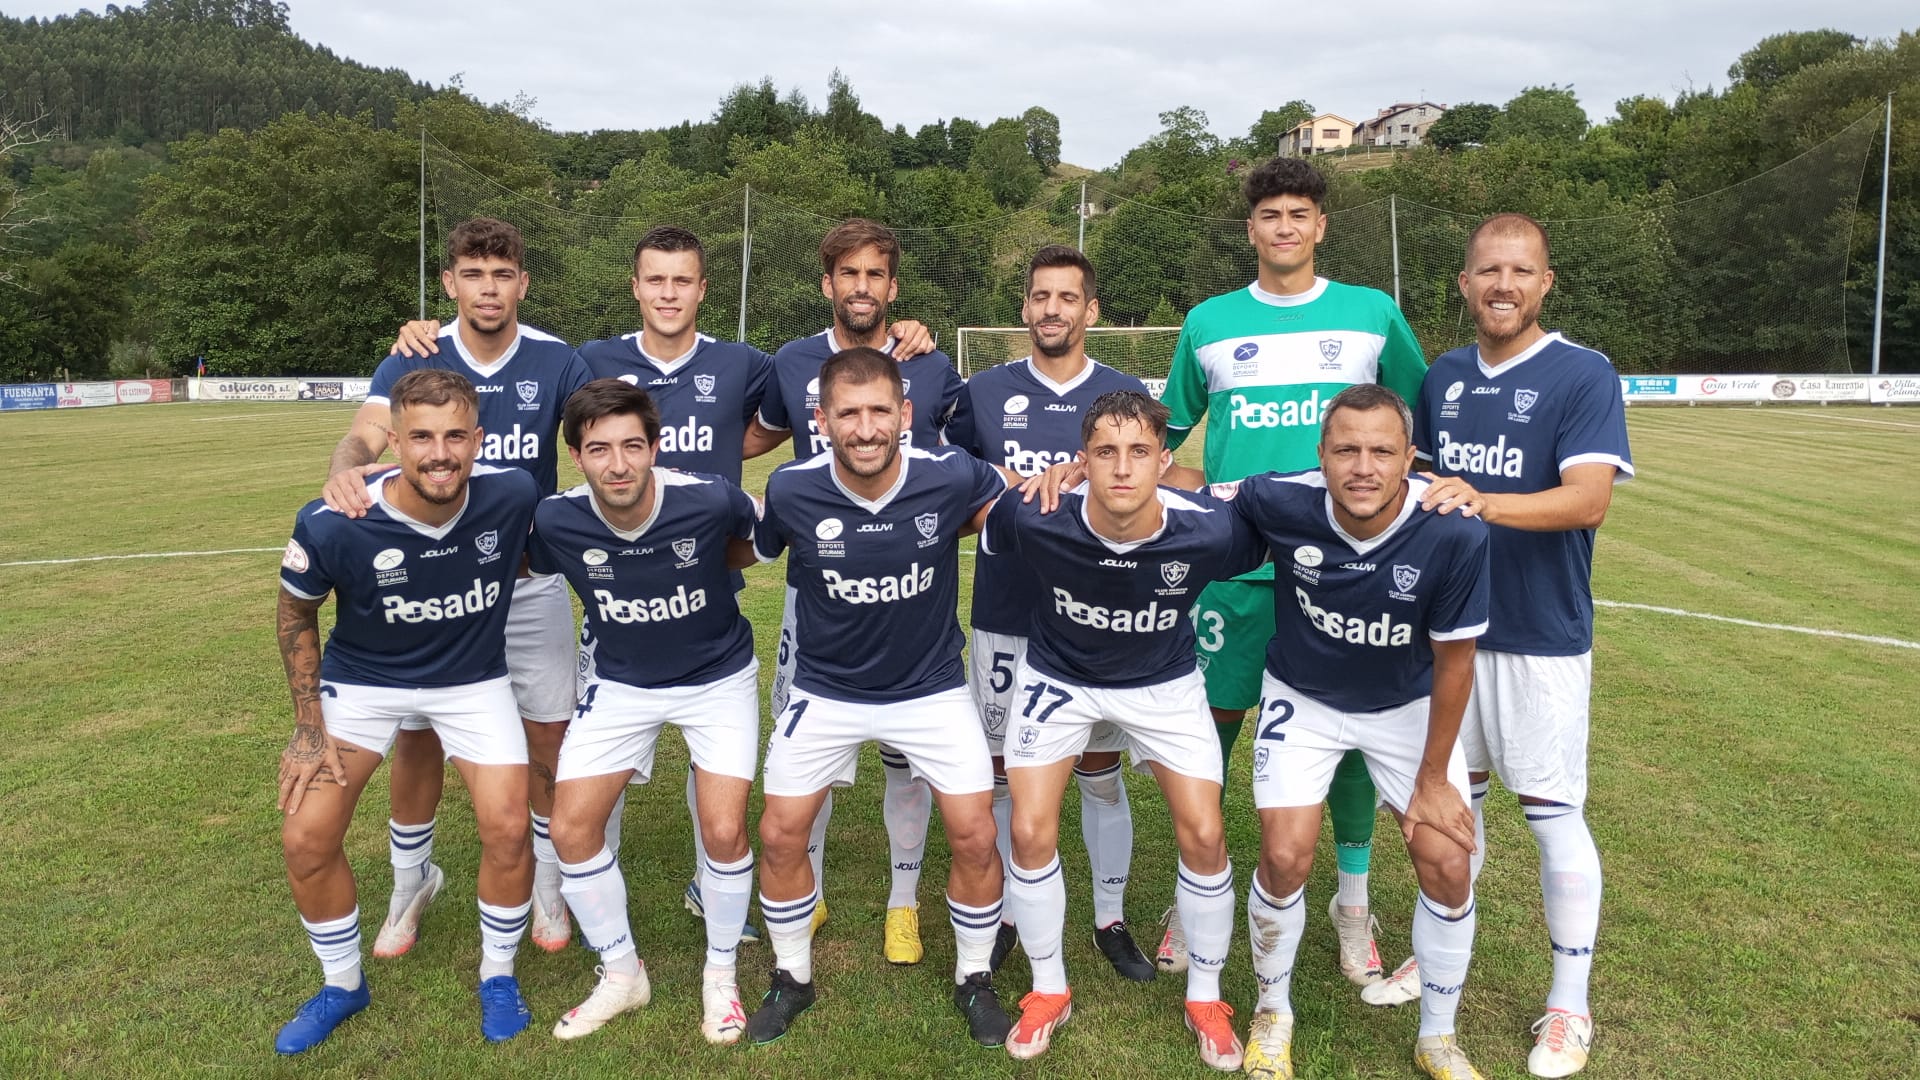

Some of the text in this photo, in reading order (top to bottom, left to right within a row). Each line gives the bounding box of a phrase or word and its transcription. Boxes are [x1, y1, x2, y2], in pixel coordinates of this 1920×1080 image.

[4, 387, 55, 398] FUENSANTA
[1700, 377, 1760, 394] Costa Verde
[1800, 380, 1821, 390] Casa
[1893, 379, 1916, 388] Villa
[1438, 430, 1523, 479] Posada
[856, 523, 894, 533] JOLUVI
[419, 546, 459, 559] JOLUVI
[1098, 558, 1138, 569] JOLUVI
[376, 570, 408, 580] DEPORTE
[822, 562, 935, 605] Posada
[382, 577, 501, 624] Posada
[593, 584, 707, 624] Posada
[1053, 586, 1179, 633] Posada
[1296, 585, 1412, 647] Posada
[990, 651, 1015, 693] 5
[1022, 681, 1074, 723] 17
